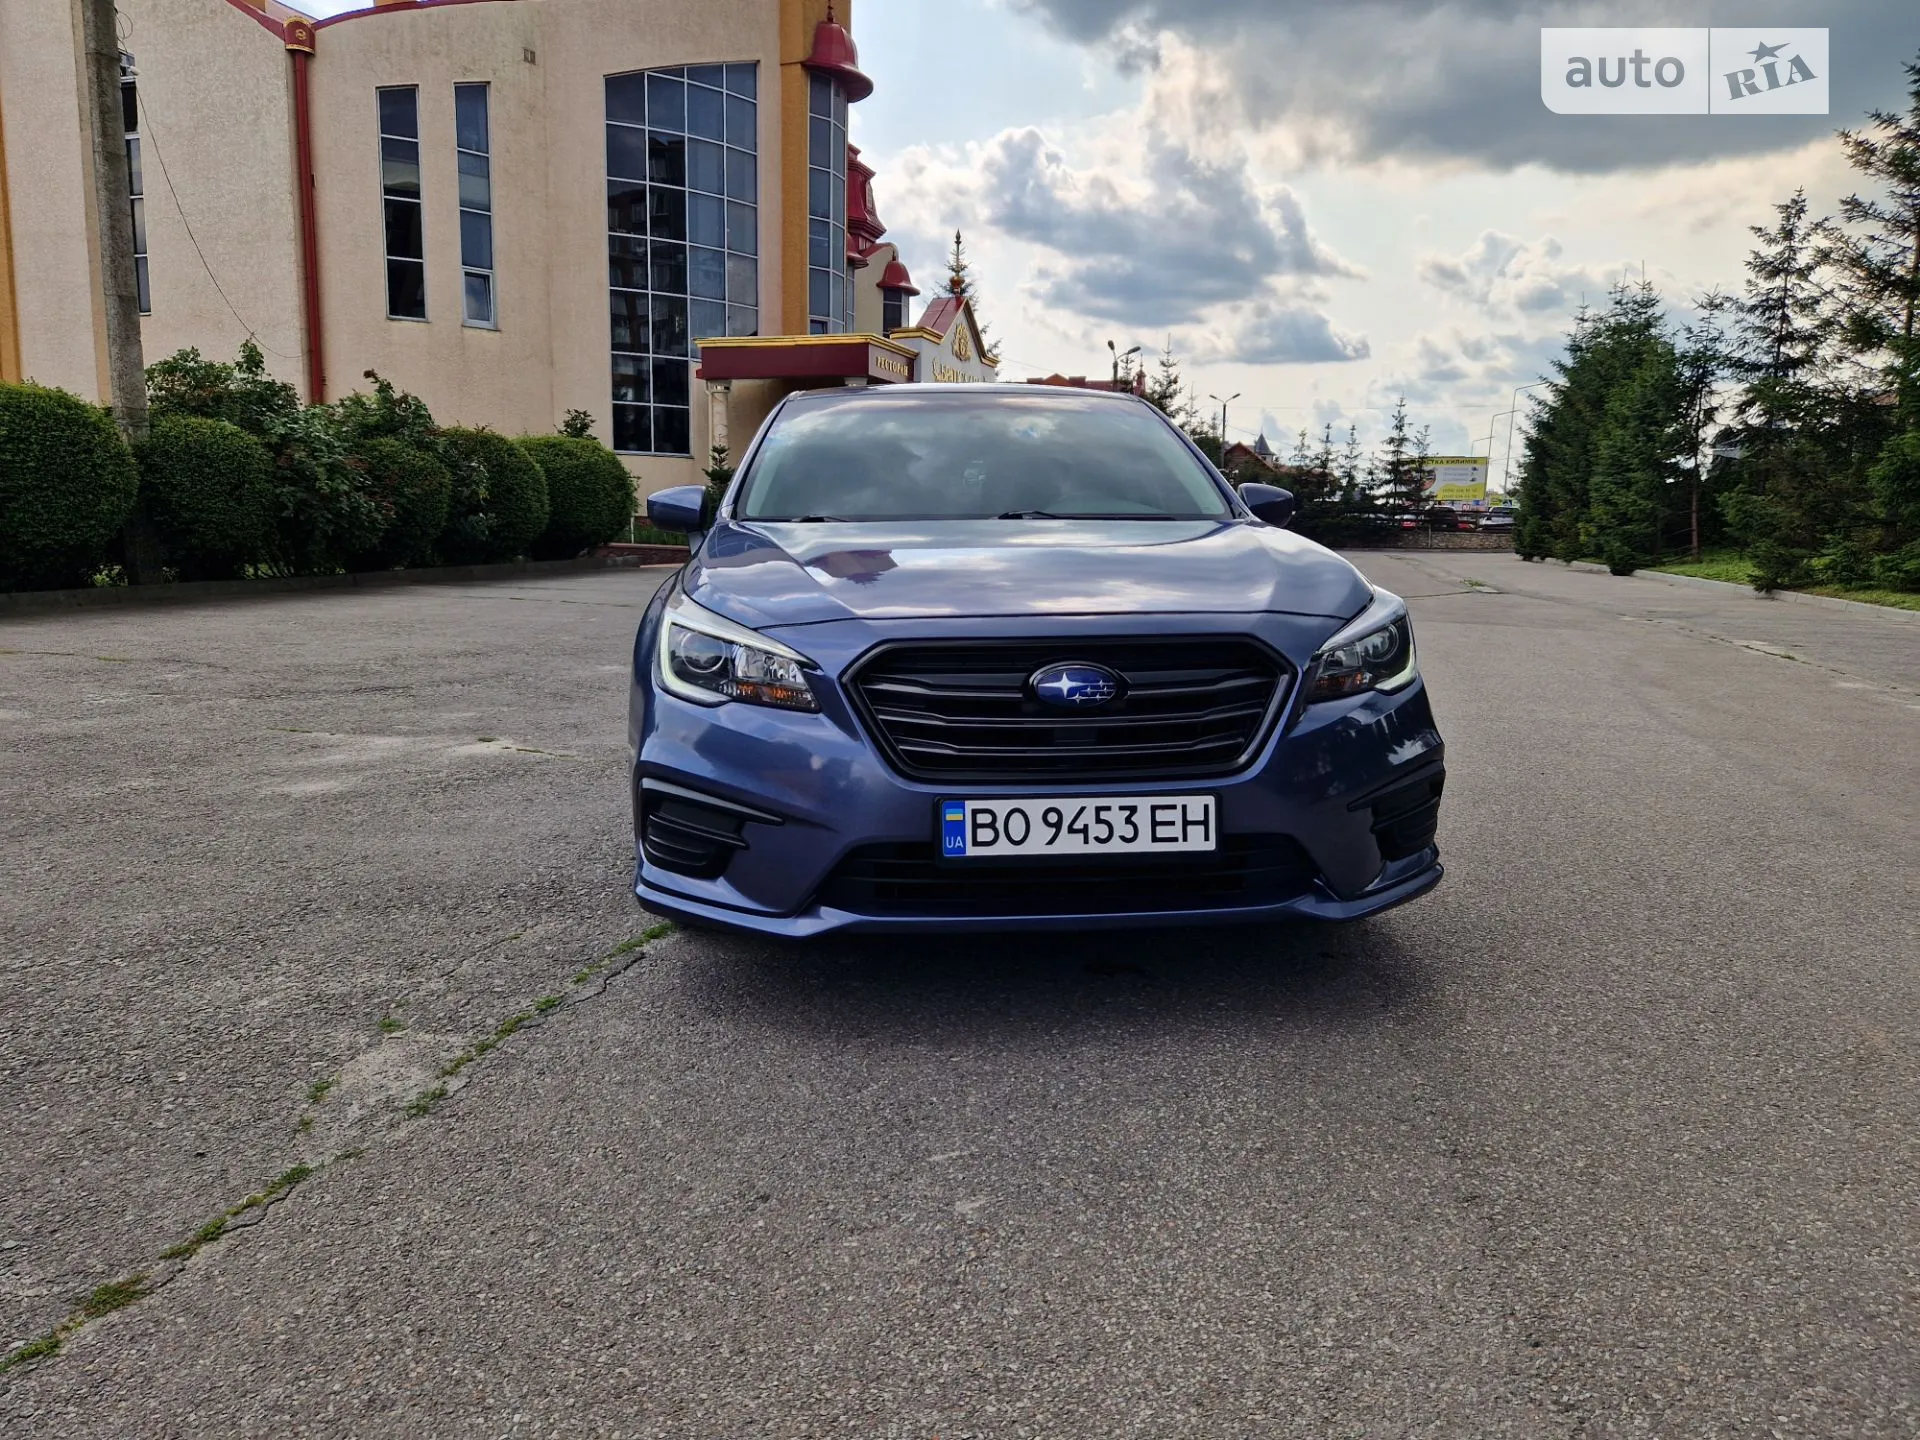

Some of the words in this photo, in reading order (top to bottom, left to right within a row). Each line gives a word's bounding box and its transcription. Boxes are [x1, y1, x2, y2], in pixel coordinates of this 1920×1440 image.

[971, 807, 1031, 847] BO
[1042, 805, 1140, 846] 9453
[1149, 803, 1211, 844] EH
[945, 835, 964, 849] UA
